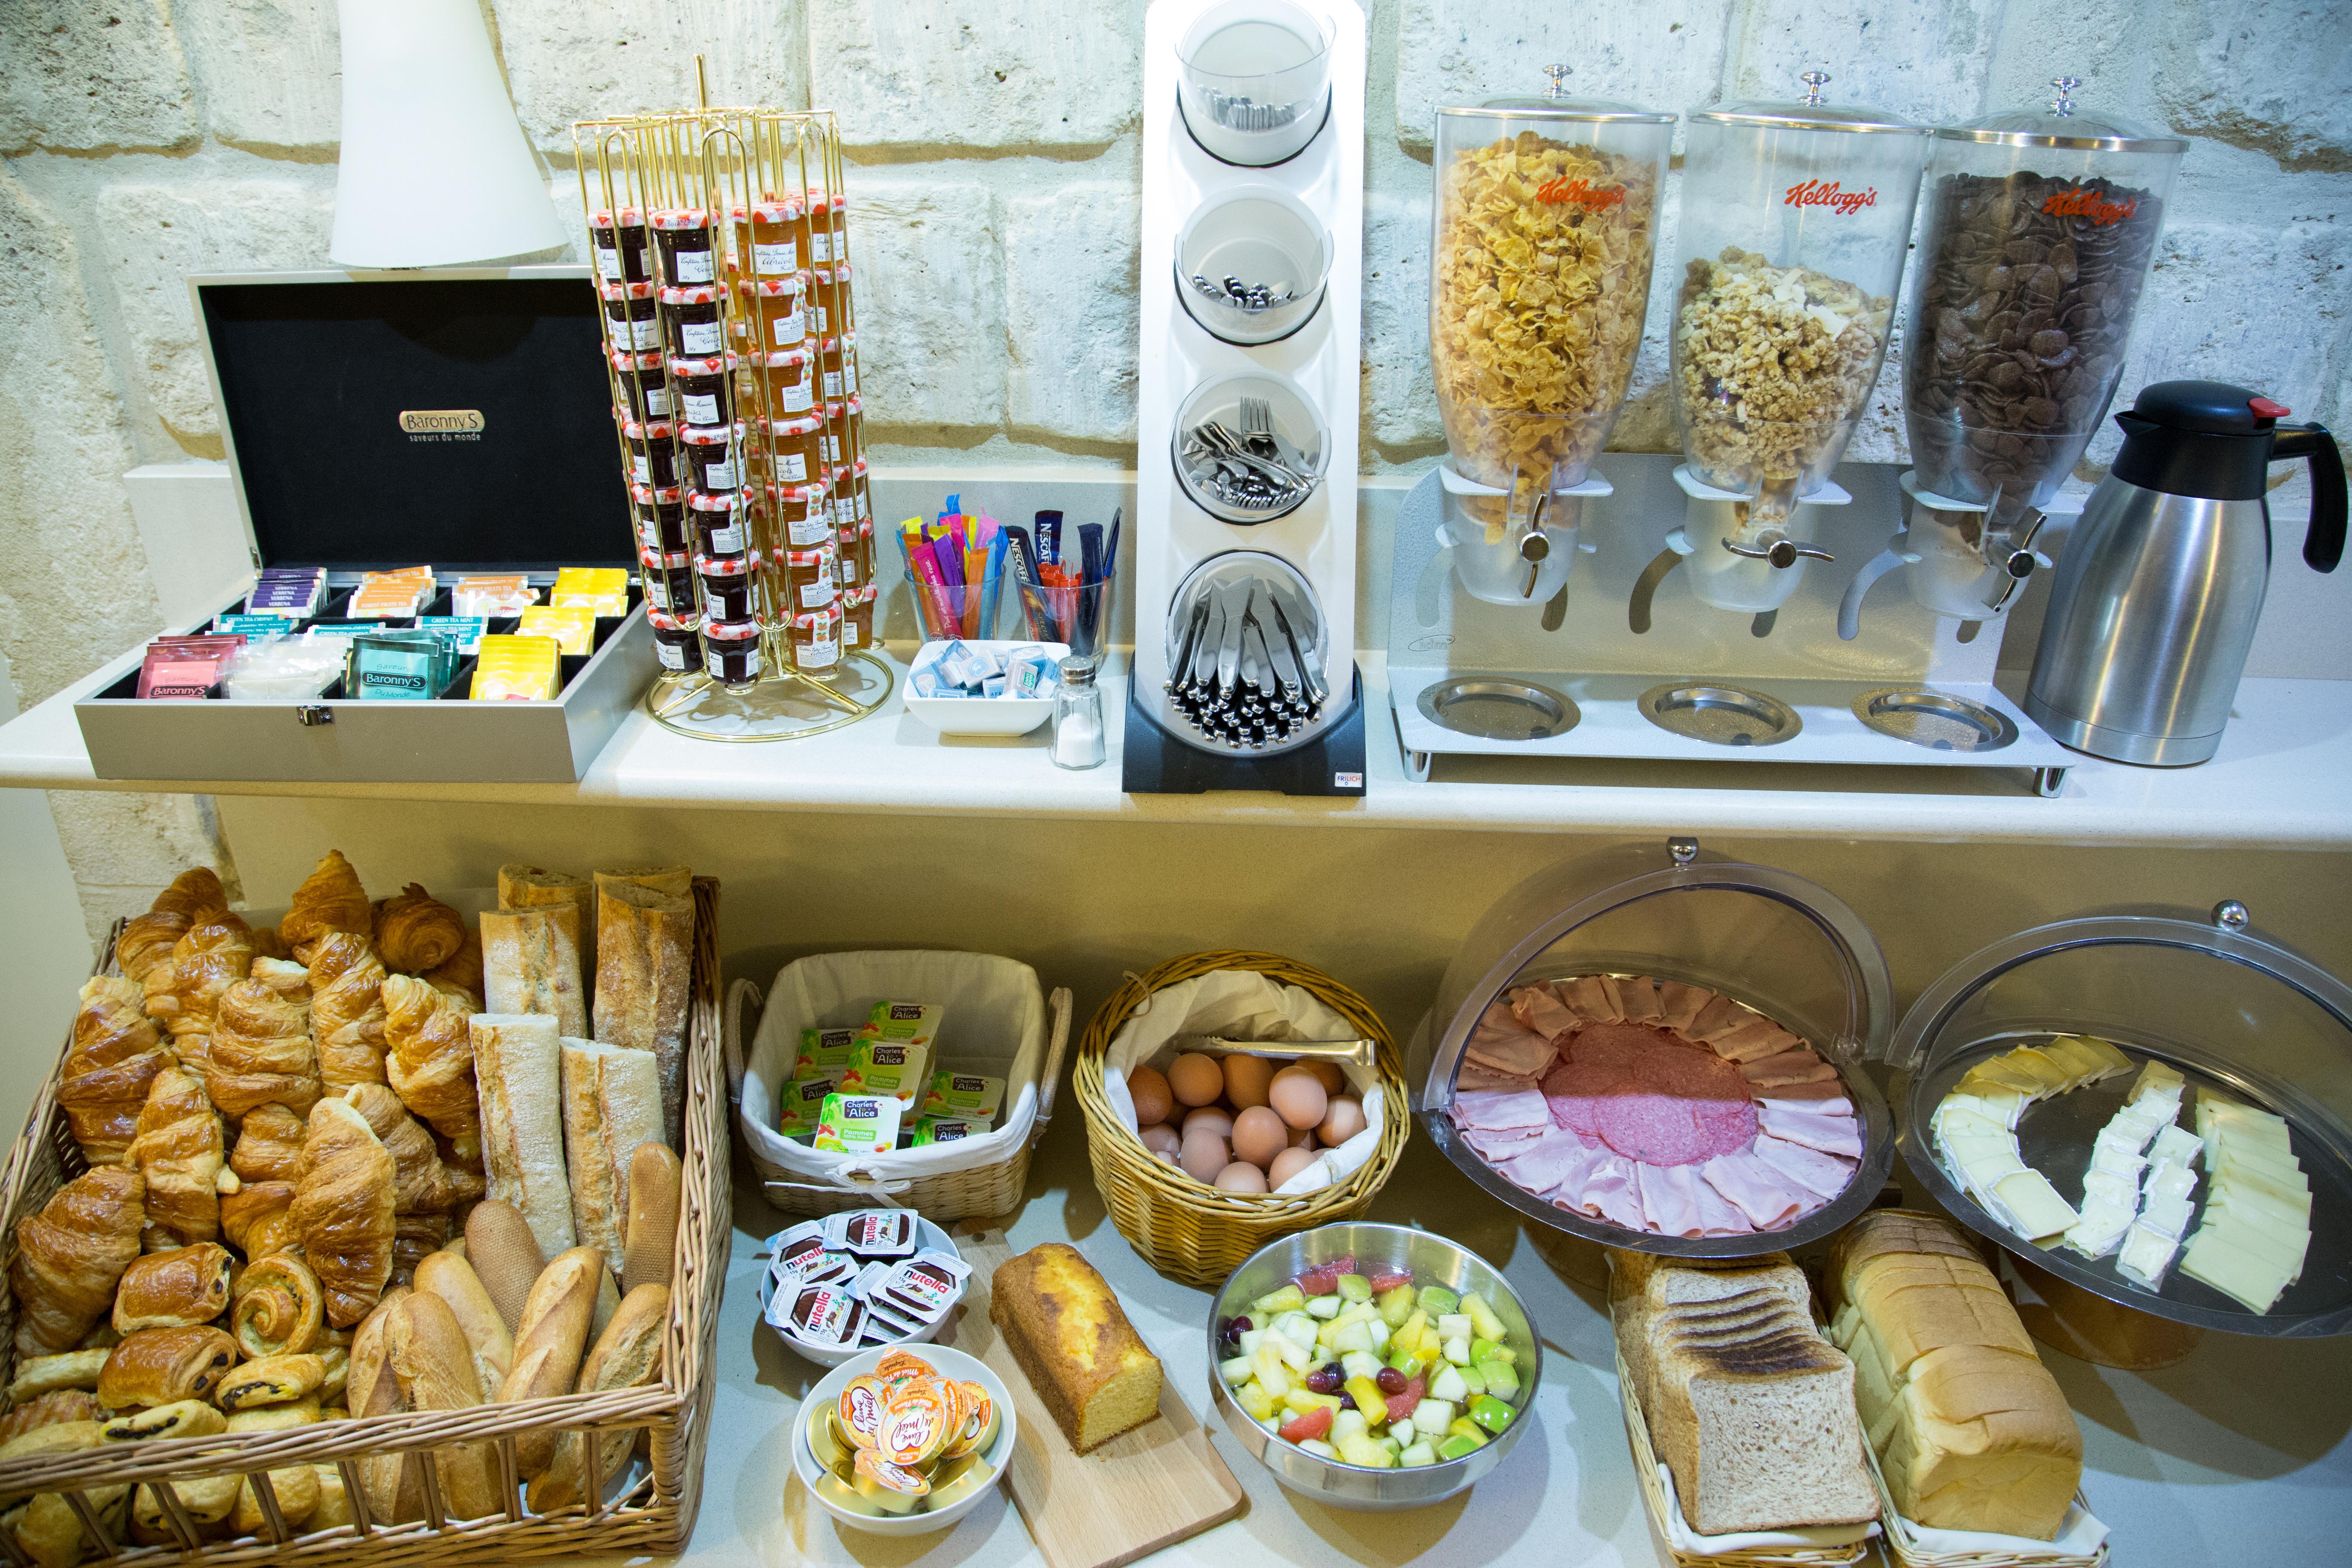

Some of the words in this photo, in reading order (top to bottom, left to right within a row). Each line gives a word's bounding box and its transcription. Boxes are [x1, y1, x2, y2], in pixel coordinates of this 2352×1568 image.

[1537, 175, 1626, 212] Kellogg's
[1784, 179, 1877, 215] Kellogg's
[442, 432, 451, 441] du
[455, 432, 480, 441] monde
[377, 664, 412, 672] Saveurs
[367, 674, 421, 687] Baronny'S
[154, 686, 205, 696] Baronny'S
[825, 1038, 848, 1047] Alice
[877, 1054, 901, 1063] Alice
[807, 1089, 831, 1099] Alice
[848, 1109, 875, 1117] Alice
[939, 1132, 963, 1140] Alice
[864, 1217, 878, 1245] nutella
[903, 1270, 949, 1294] nutella
[808, 1291, 831, 1332] nutella
[919, 1399, 932, 1407] Miel
[854, 1399, 865, 1427] lune
[867, 1427, 875, 1437] de
[902, 1430, 925, 1445] lune
